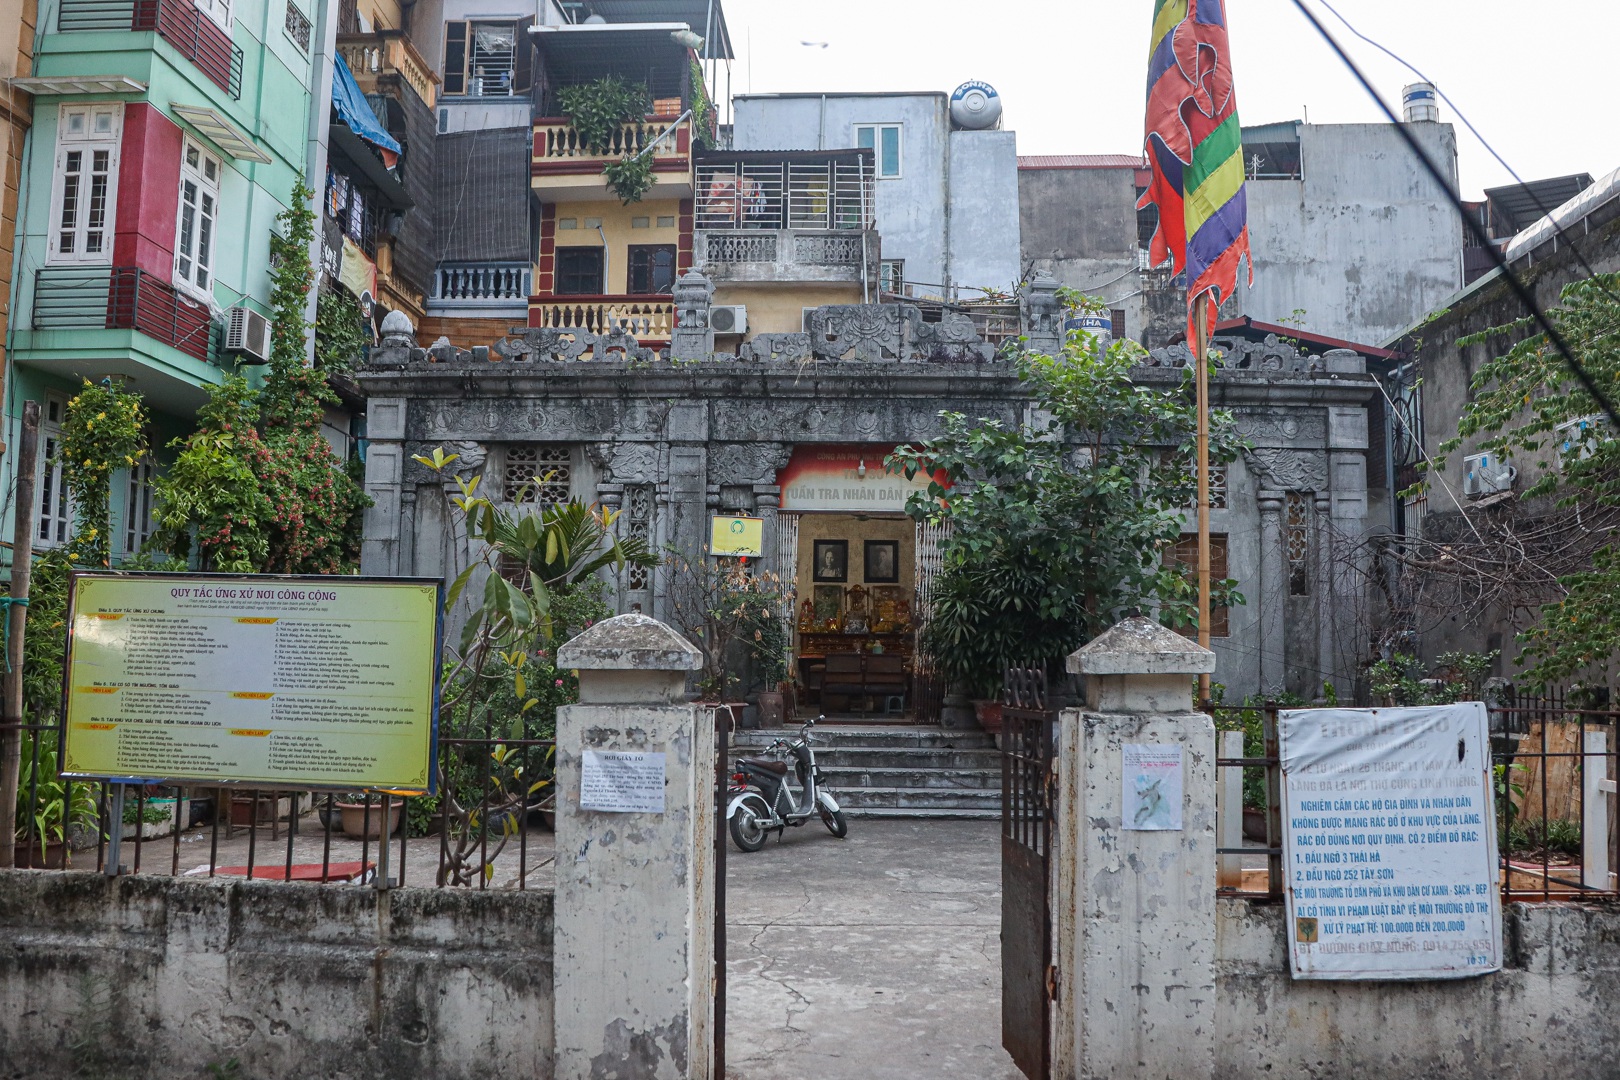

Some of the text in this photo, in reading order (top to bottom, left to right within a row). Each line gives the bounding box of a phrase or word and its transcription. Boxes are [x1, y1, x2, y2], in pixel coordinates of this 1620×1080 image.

[818, 488, 840, 500] TRA
[843, 486, 875, 500] NHÂN
[879, 486, 902, 500] DÂN
[170, 588, 191, 599] QUY
[193, 584, 213, 598] TẮC
[215, 586, 237, 598] ỨNG
[239, 587, 254, 599] XỬ
[257, 589, 274, 599] NƠI
[277, 588, 305, 600] CÔNG
[308, 589, 337, 603] CỘNG
[1359, 761, 1370, 773] 26
[1420, 776, 1442, 788] LINH
[1301, 794, 1472, 812] NGHIÊM CẤM CÁC HỘ GIA ĐÌNH VÀ NHÂN DÂN
[1292, 810, 1482, 831] KHÔNG ĐƯỢC MANG RÁC ĐỔ Ở KHU VỰC CỦA LĂNG.
[1297, 828, 1479, 847] RÁC ĐỔ ĐÚNG NƠI QUY ĐỊNH. CÓ 2 ĐIỂM ĐỔ RÁC:
[1296, 854, 1304, 864] 1.
[1323, 851, 1341, 863] NGÕ
[1342, 853, 1348, 863] 3
[1350, 850, 1368, 863] THÁI
[1370, 850, 1381, 862] HÀ
[1296, 870, 1304, 881] 2.
[1324, 868, 1342, 880] NGÕ
[1343, 869, 1358, 880] 252
[1360, 867, 1375, 880] TÂY
[1377, 868, 1394, 879] SƠN
[1304, 886, 1317, 899] MÔI
[1318, 885, 1344, 898] TRƯỜNG
[1345, 883, 1353, 898] TỔ
[1354, 885, 1368, 898] DÂN
[1368, 883, 1382, 897] PHỐ
[1382, 884, 1392, 897] VÀ
[1393, 886, 1406, 897] KHU
[1407, 884, 1420, 897] DÂN
[1421, 885, 1431, 896] CƯ
[1431, 885, 1449, 896] XANH
[1454, 884, 1471, 898] SẠCH
[1475, 884, 1488, 897] ĐẸP
[1297, 907, 1305, 917] AI
[1307, 903, 1317, 917] CỐ
[1319, 903, 1336, 917] TÌNH
[1338, 906, 1346, 916] VI
[1347, 905, 1369, 919] PHẠM
[1371, 902, 1389, 918] LUẬT
[1408, 902, 1417, 917] VỆ
[1418, 902, 1433, 915] MÔI
[1435, 901, 1463, 914] TRƯỜNG
[1465, 900, 1475, 914] ĐÔ
[1323, 919, 1334, 934] XỬ
[1336, 921, 1344, 934] LÝ
[1346, 923, 1365, 936] PHẠT
[1366, 920, 1378, 933] TỪ:
[1415, 918, 1431, 932] ĐẾN
[1477, 956, 1487, 965] 37
